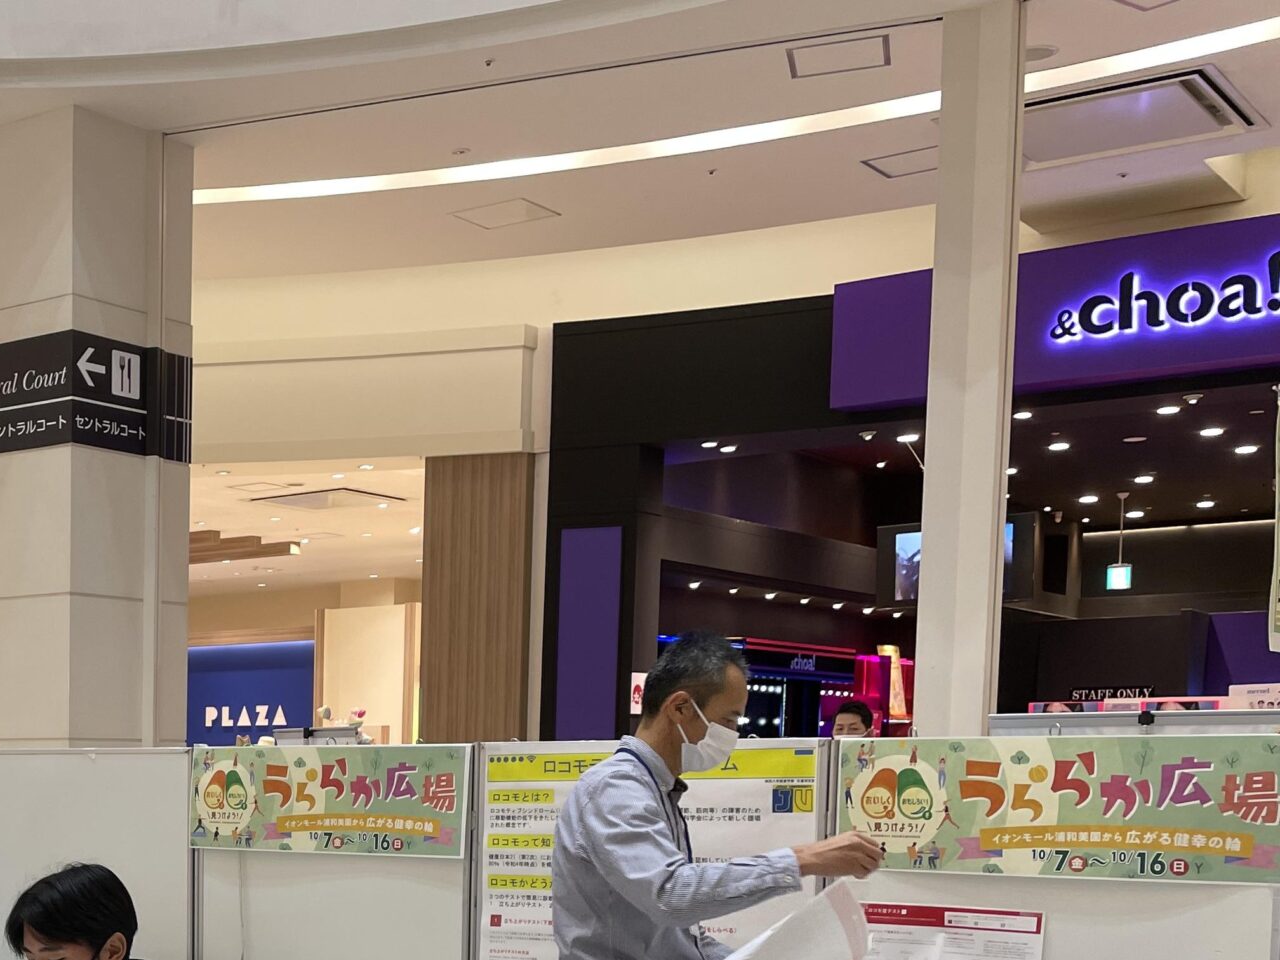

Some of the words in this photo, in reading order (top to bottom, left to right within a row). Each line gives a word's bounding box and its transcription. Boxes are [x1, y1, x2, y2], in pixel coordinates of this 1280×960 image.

[22, 366, 68, 392] Court
[75, 414, 146, 440] セントラルコート
[1072, 689, 1113, 700] STAFF
[1117, 688, 1152, 699] ONLY
[205, 705, 287, 727] PLAZA
[262, 758, 457, 813] うららか広場
[493, 793, 549, 802] ロコモとは？
[958, 751, 1280, 826] うららか広場
